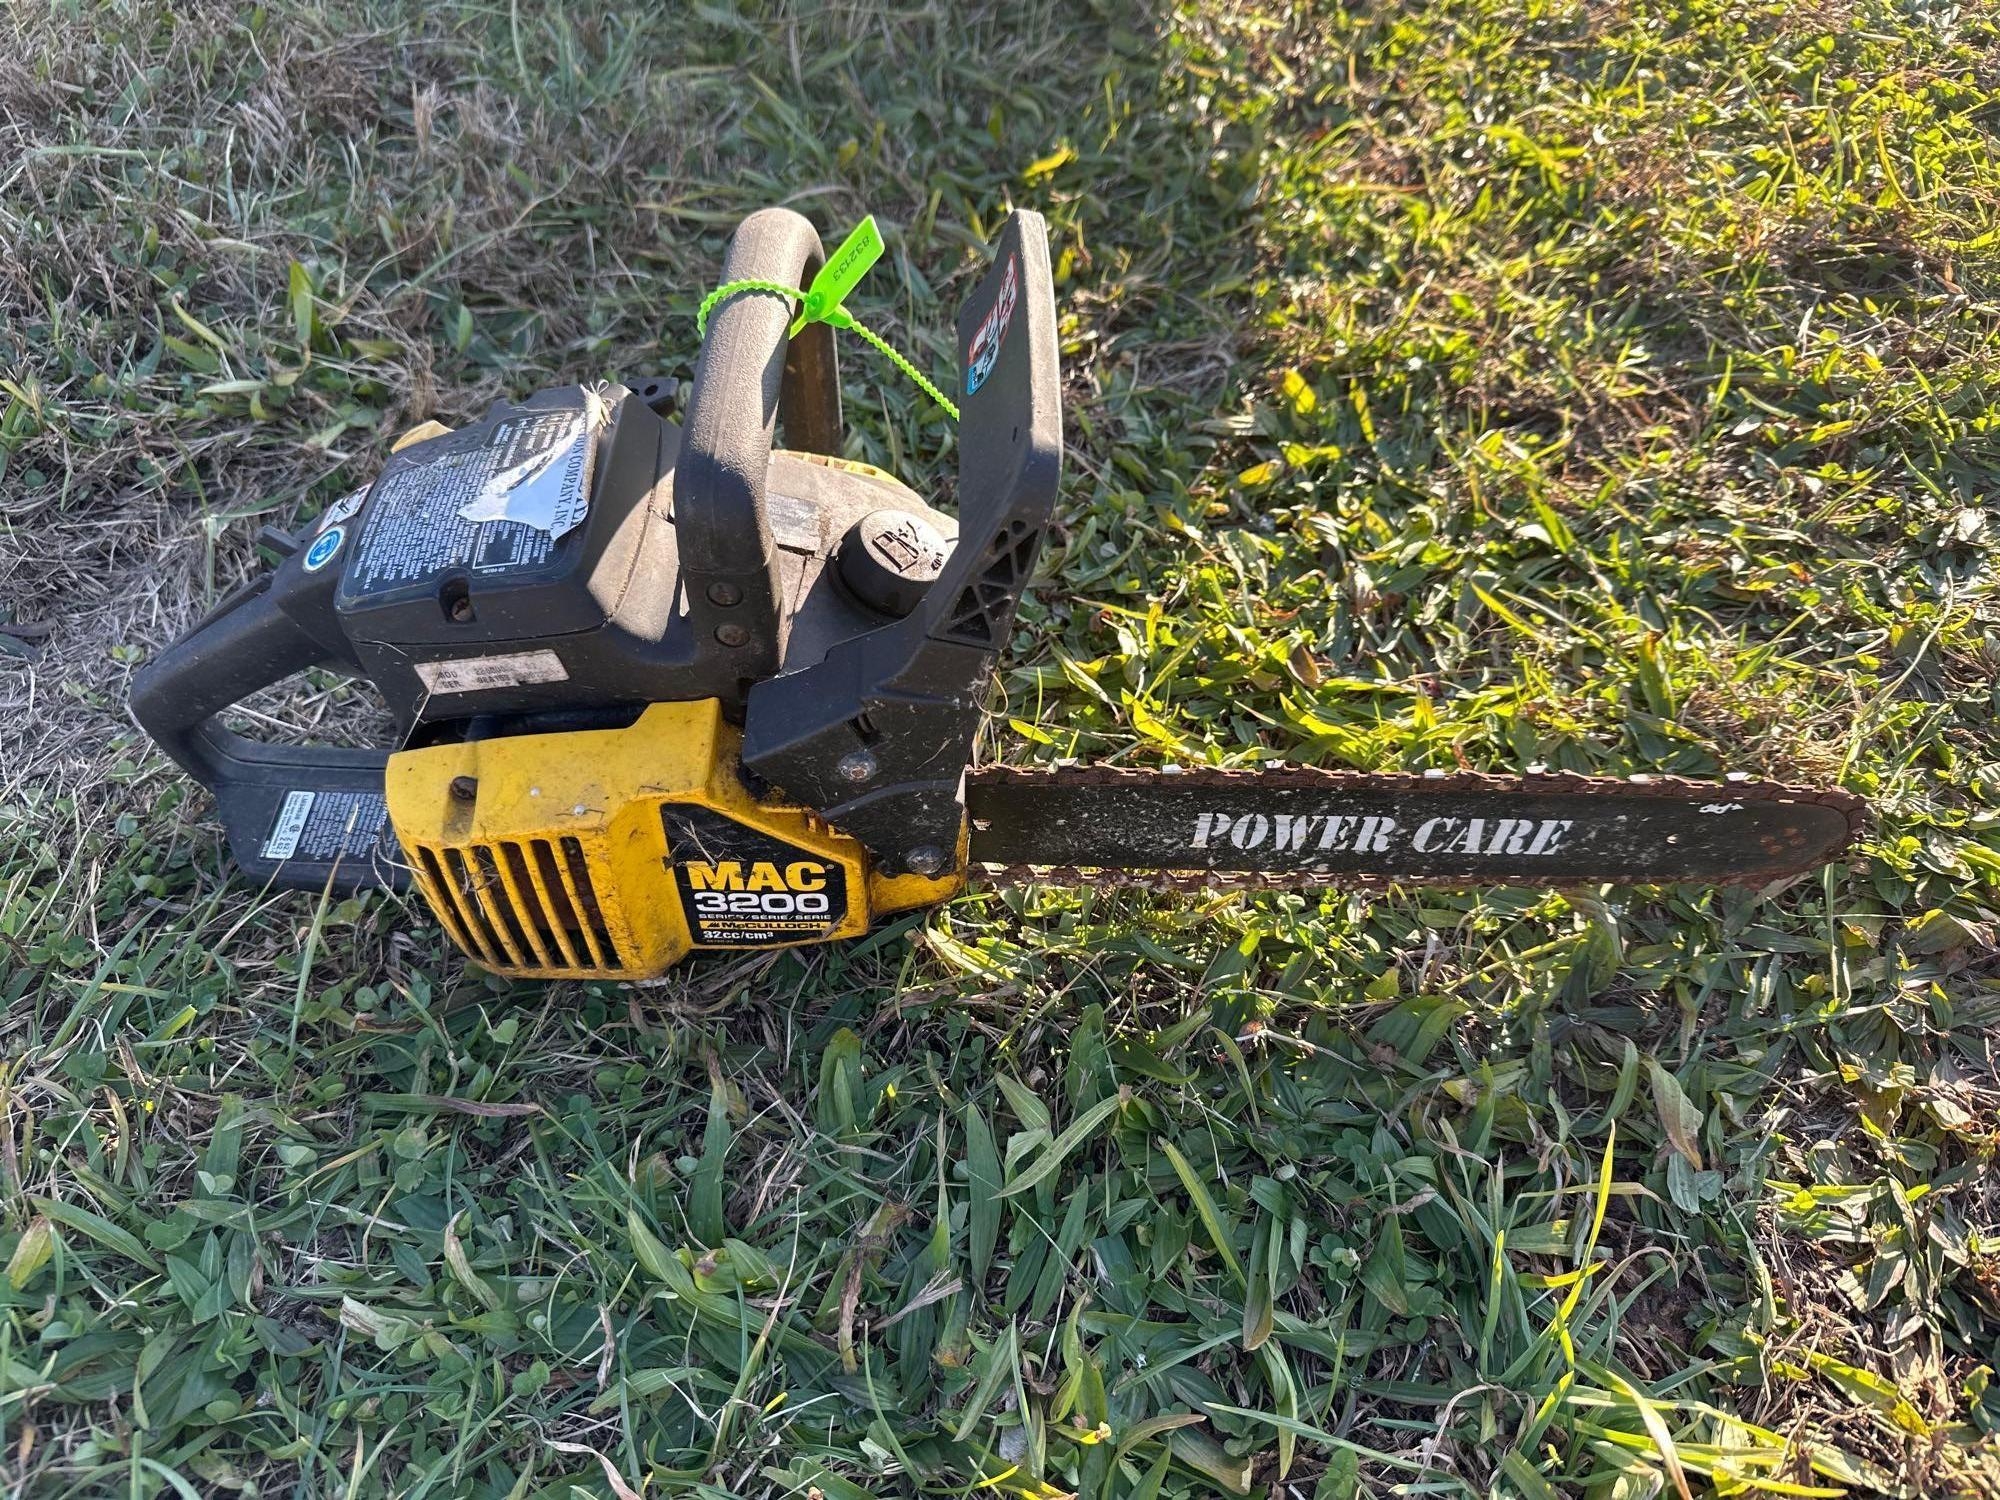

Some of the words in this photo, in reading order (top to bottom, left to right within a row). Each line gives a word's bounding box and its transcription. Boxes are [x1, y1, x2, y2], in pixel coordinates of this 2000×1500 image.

[832, 236, 870, 281] 832133
[1188, 812, 1397, 852] POWER
[1411, 816, 1574, 856] CARE
[693, 891, 830, 914] 3200
